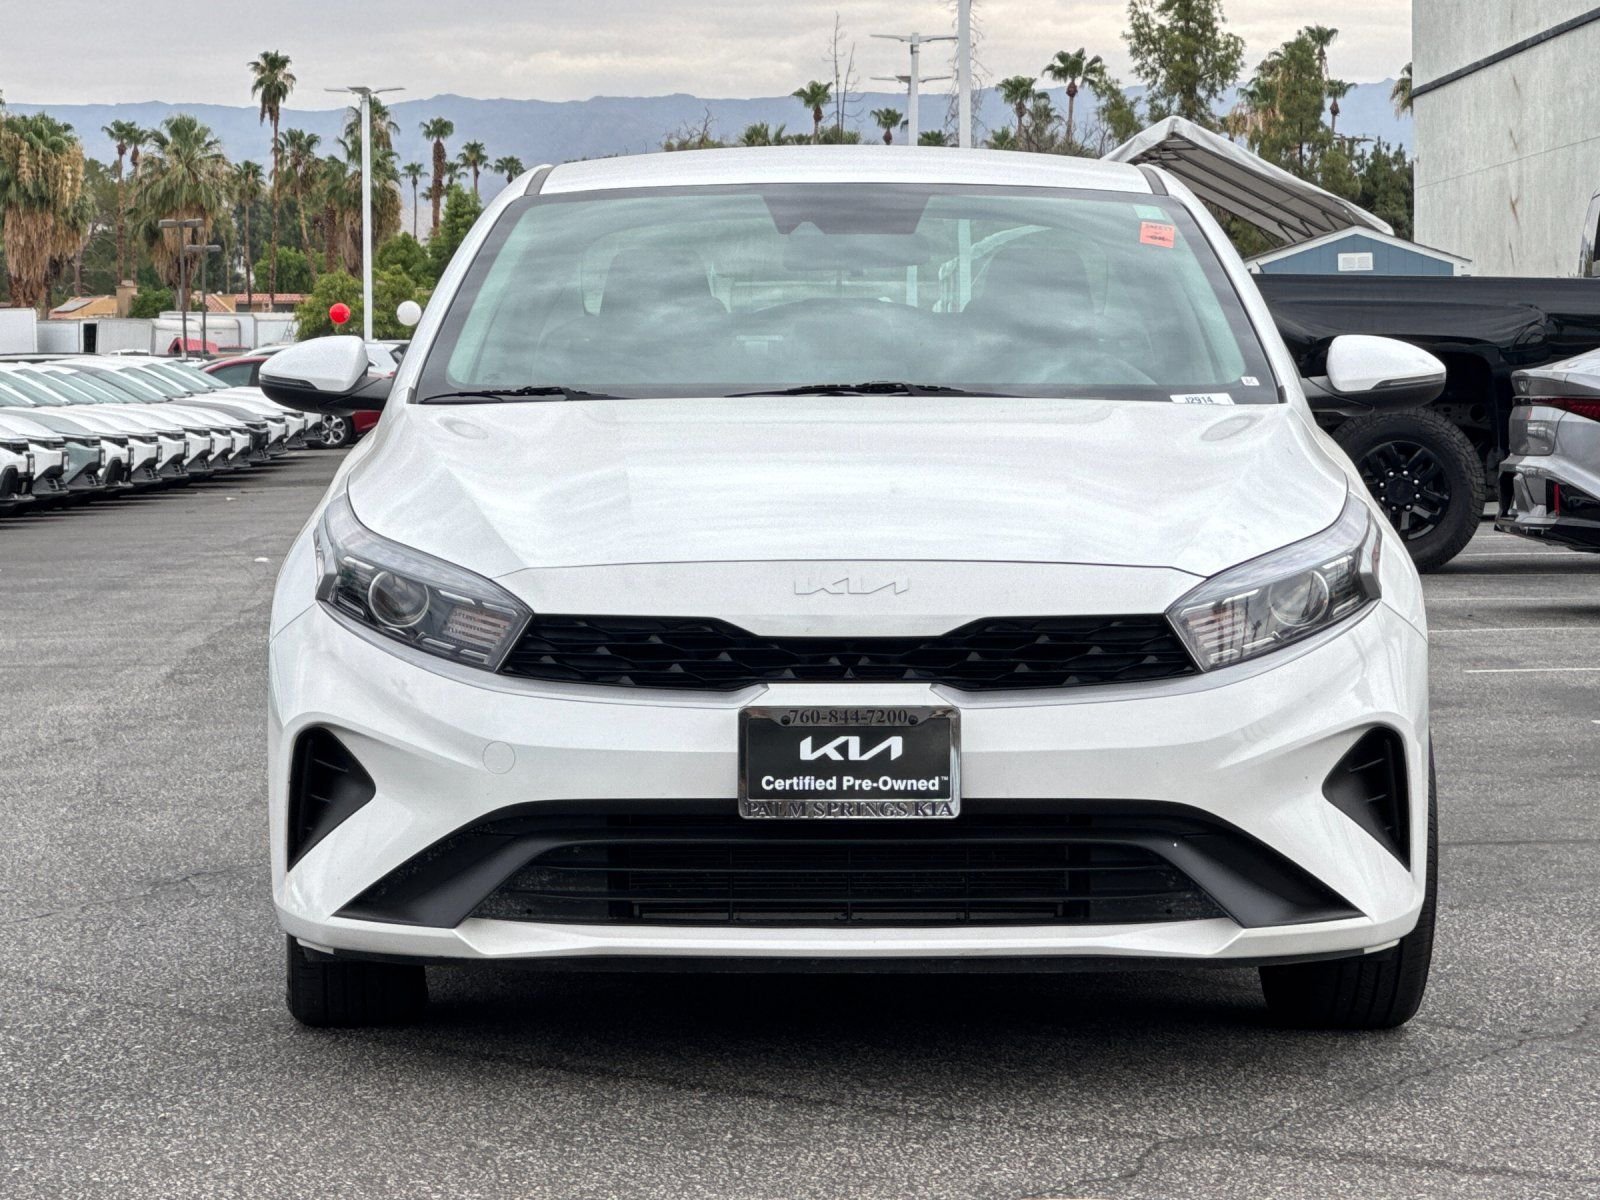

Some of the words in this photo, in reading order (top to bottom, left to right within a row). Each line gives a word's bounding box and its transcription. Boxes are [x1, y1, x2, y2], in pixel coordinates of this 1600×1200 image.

[794, 577, 909, 595] KIA
[789, 709, 908, 724] 760-844-7200
[800, 735, 903, 761] KIA
[761, 775, 837, 790] Certified
[746, 801, 808, 817] PALM
[813, 801, 907, 817] SPRINGS
[914, 801, 954, 817] KIA
